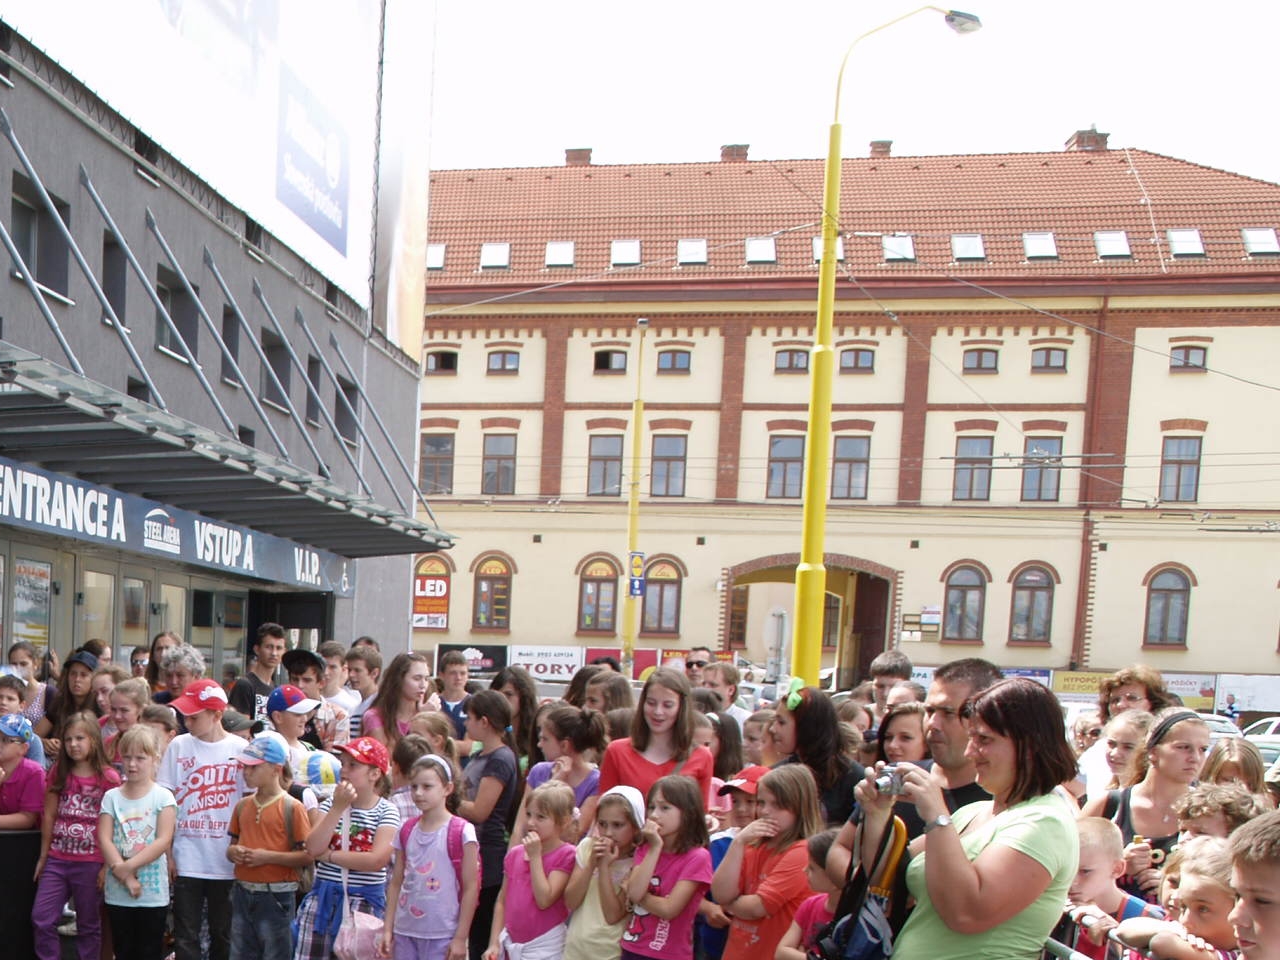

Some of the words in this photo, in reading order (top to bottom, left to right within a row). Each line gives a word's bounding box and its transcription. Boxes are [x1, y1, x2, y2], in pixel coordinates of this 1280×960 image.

[111, 497, 127, 543] A
[144, 520, 163, 541] STEEL
[162, 524, 180, 546] ARENA
[194, 520, 241, 567] VSTUP
[243, 534, 254, 571] A
[294, 547, 321, 586] V.I.P.
[415, 579, 447, 597] LED
[512, 663, 577, 674] TORY
